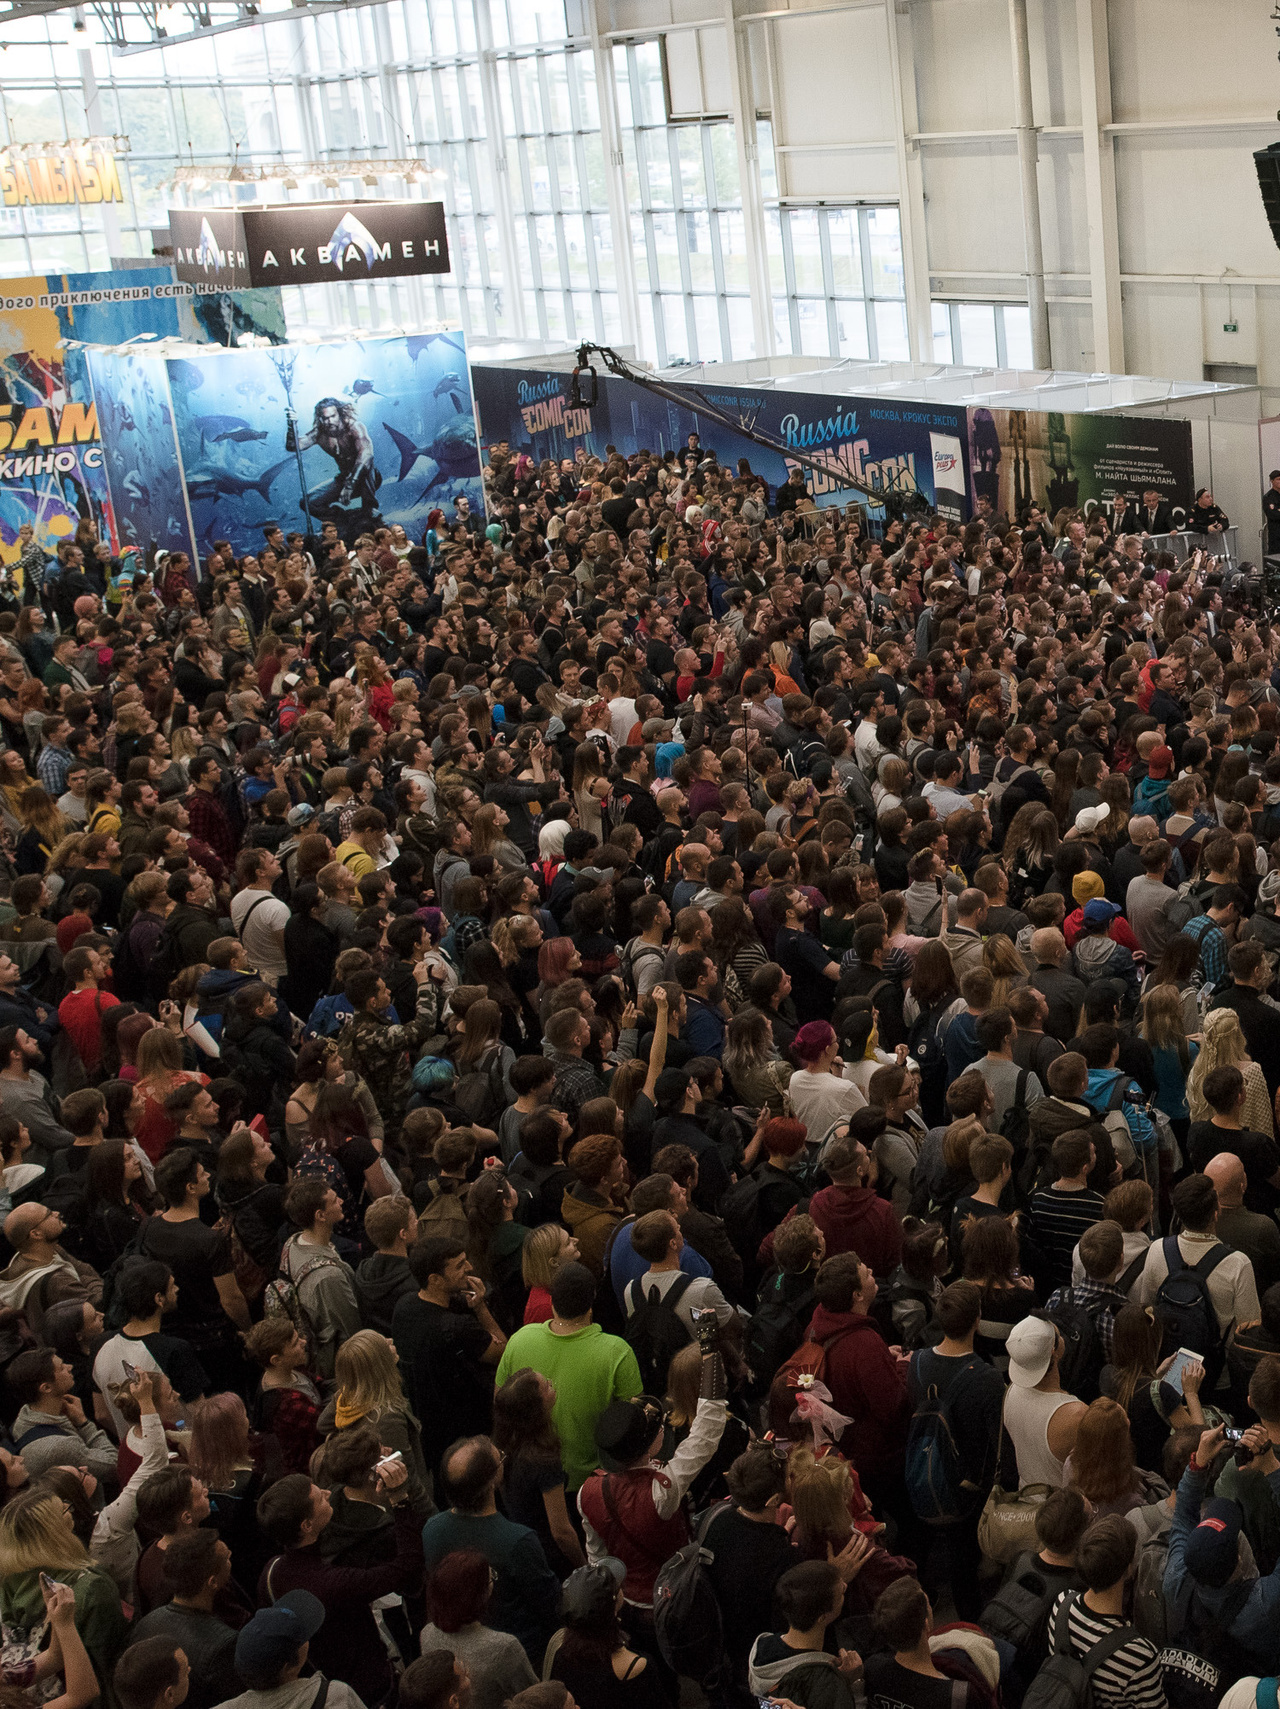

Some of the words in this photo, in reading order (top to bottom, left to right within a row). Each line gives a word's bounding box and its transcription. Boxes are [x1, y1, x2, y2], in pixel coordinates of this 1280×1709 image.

[177, 247, 246, 269] АКВАМЕН
[262, 239, 440, 268] АКВАМЕН
[40, 285, 150, 311] приключения
[156, 283, 193, 297] есть
[517, 374, 560, 405] Russia
[521, 395, 567, 435] COMIC
[564, 408, 593, 440] CON
[780, 404, 860, 449] Russia
[870, 409, 901, 422] МОСКВА,
[903, 413, 931, 425] КРОКУС
[933, 415, 958, 427] ЭКСПО
[84, 448, 103, 468] С
[1105, 471, 1128, 481] НАЙТА
[1130, 475, 1177, 486] ШЬЯМАЛАНА
